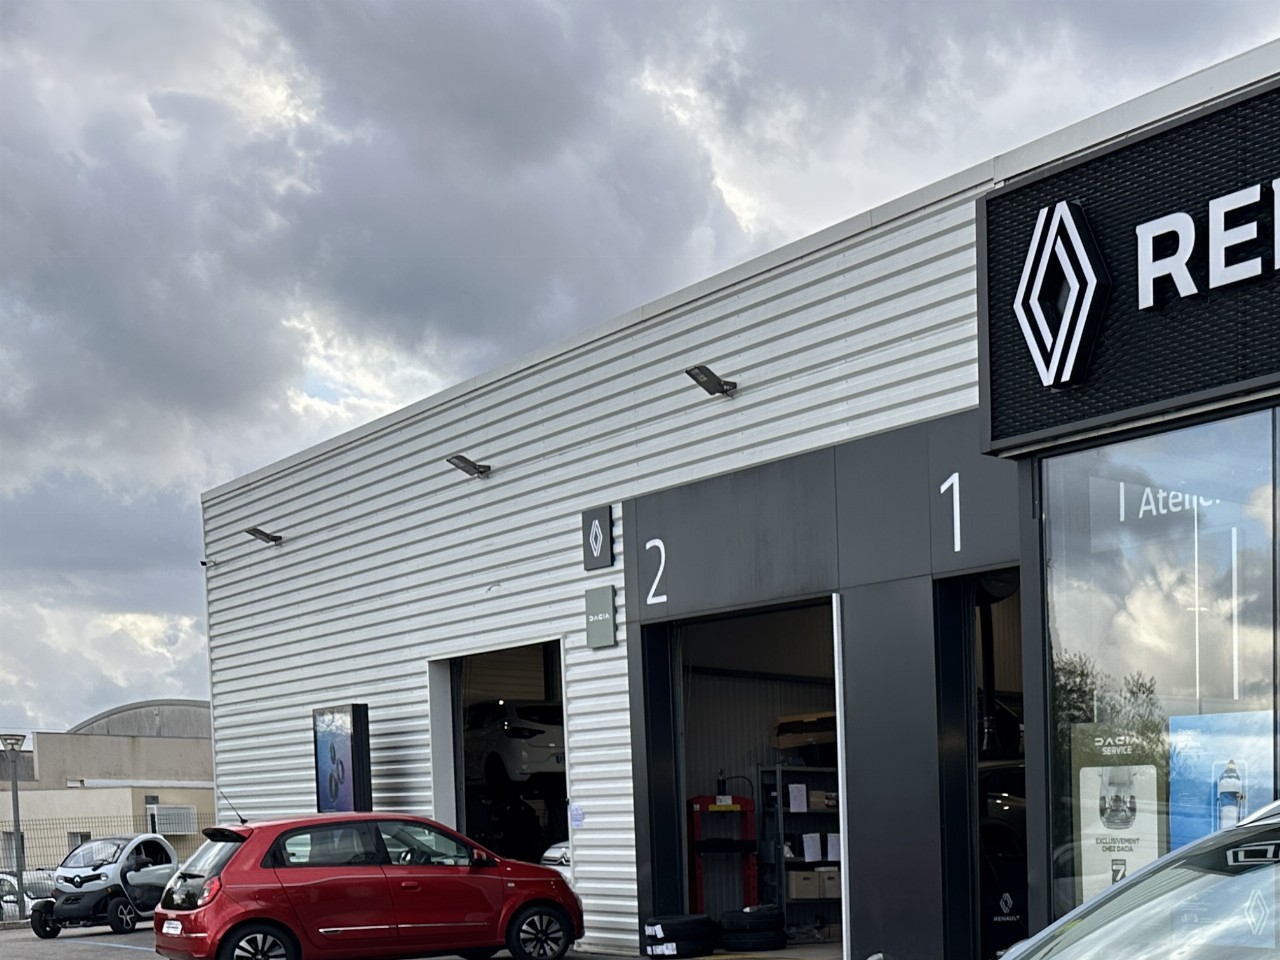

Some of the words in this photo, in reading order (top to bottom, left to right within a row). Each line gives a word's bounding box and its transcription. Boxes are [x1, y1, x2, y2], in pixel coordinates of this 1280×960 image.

[940, 472, 961, 552] 1
[645, 538, 668, 605] 2
[588, 612, 610, 622] DACIA
[1101, 745, 1132, 756] SERVICE
[1095, 837, 1140, 845] EXCLUSIVEMENT
